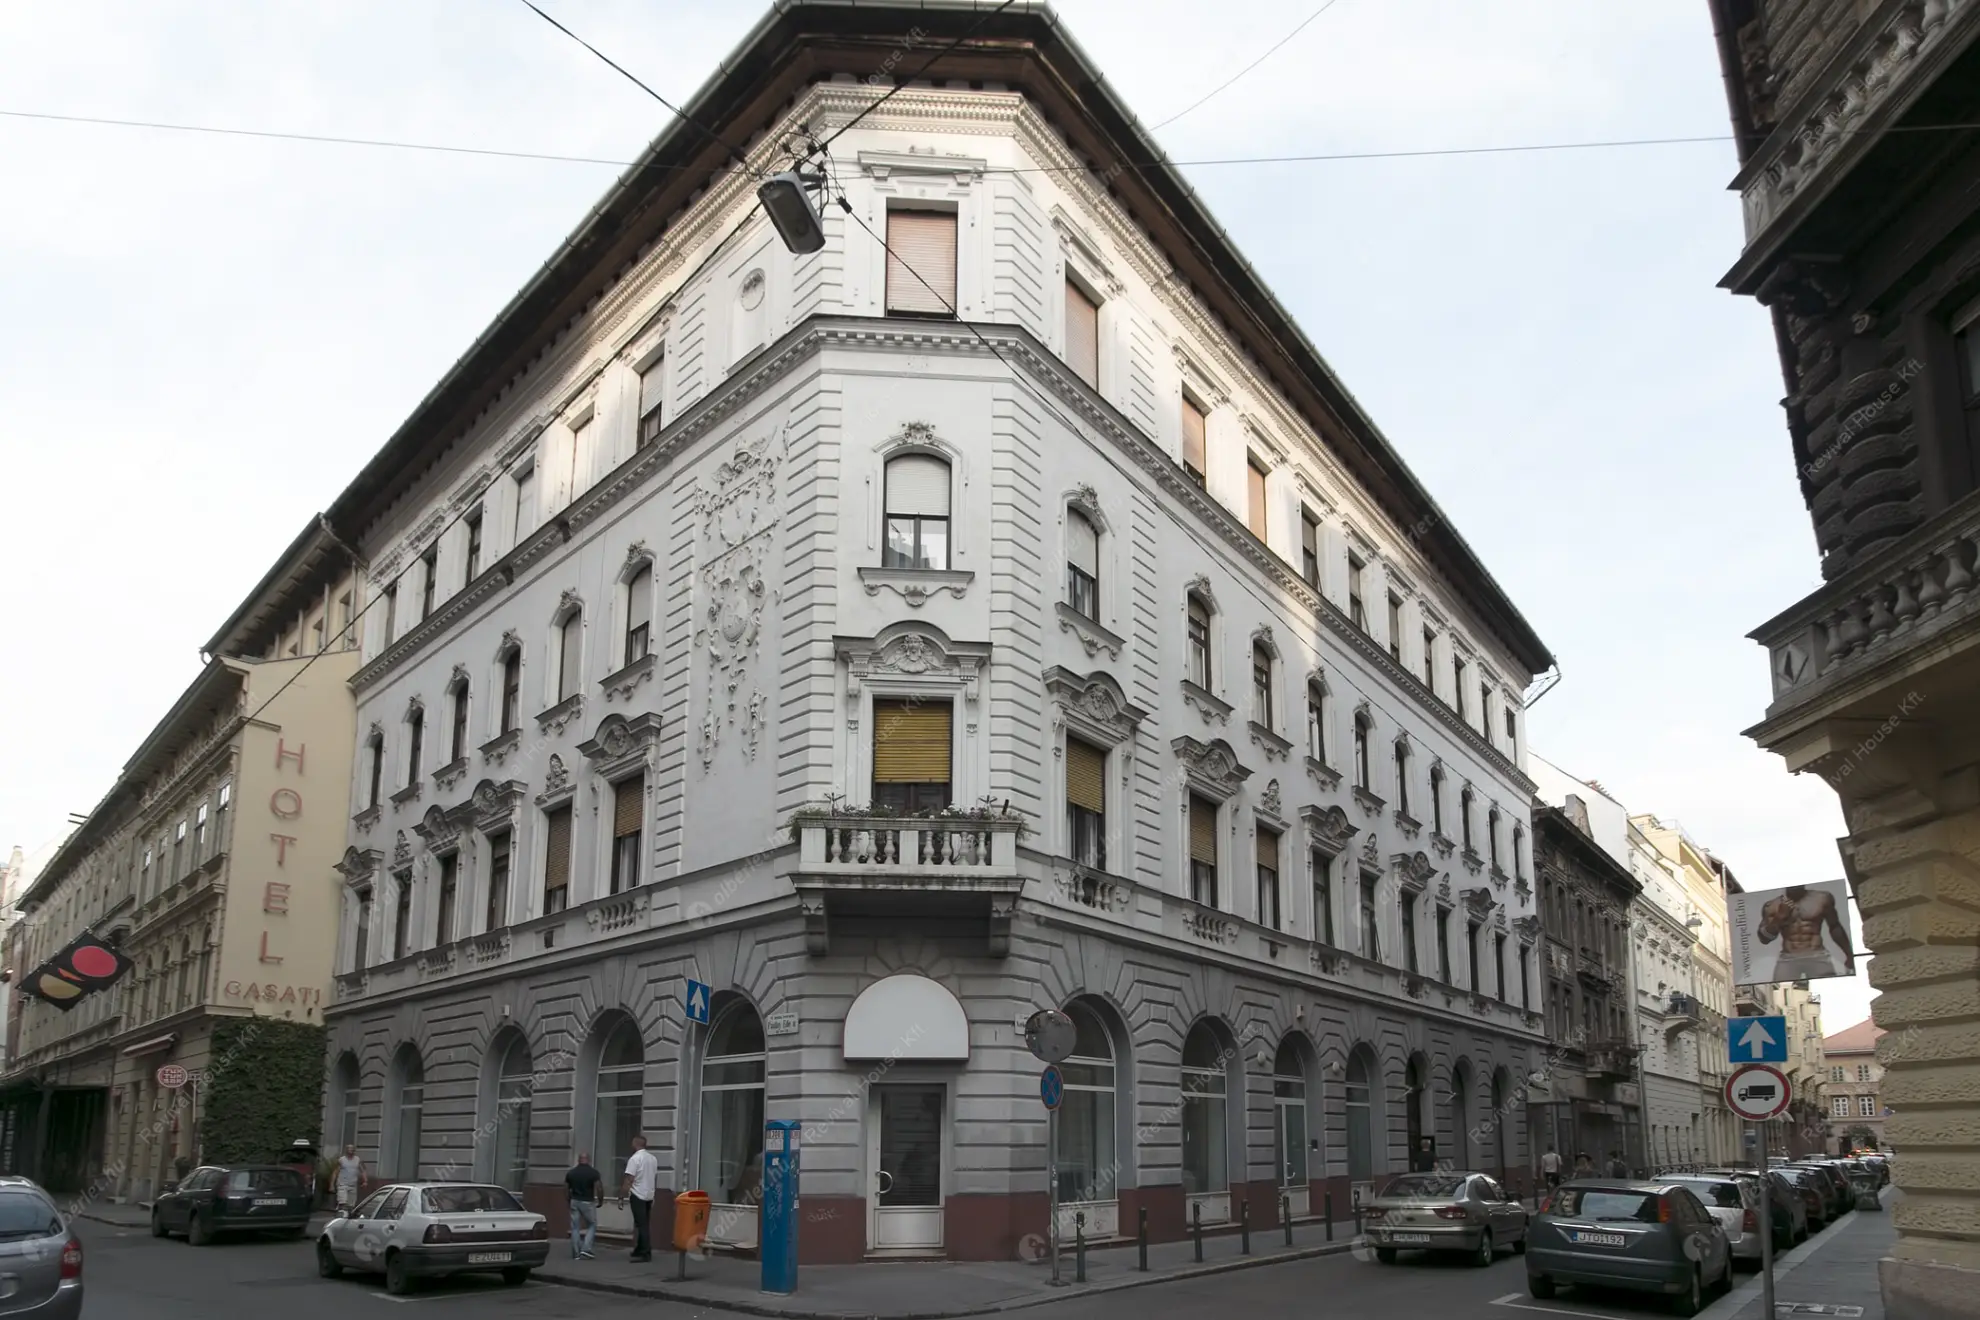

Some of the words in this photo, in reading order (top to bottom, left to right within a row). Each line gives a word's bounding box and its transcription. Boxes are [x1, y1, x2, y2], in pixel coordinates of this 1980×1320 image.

[258, 737, 305, 964] HOTEL
[1734, 899, 1751, 979] www.tempelfit.hu
[224, 980, 321, 1006] CASATI
